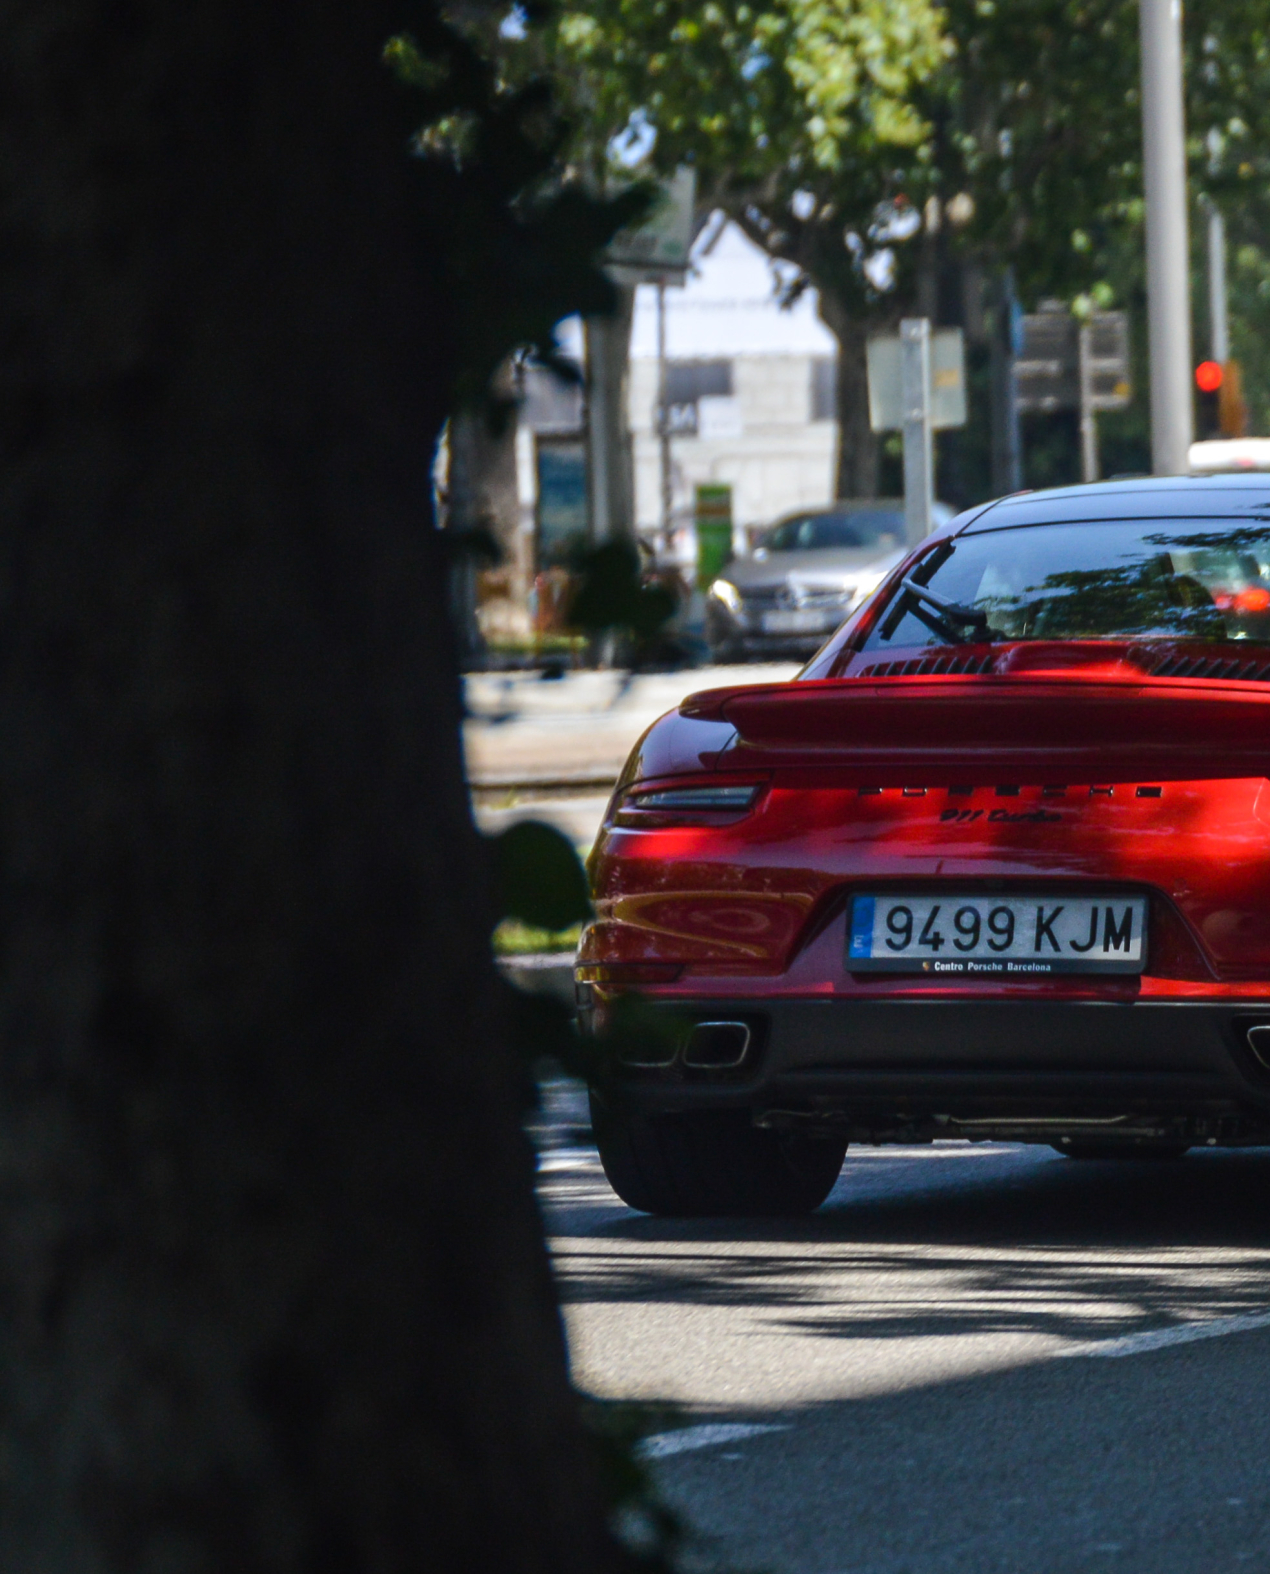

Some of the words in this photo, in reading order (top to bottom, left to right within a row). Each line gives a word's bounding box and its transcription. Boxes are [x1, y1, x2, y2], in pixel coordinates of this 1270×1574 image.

[857, 785, 1162, 799] POCH
[939, 809, 985, 822] 911
[885, 905, 1015, 952] 9499
[1034, 905, 1133, 953] KJM
[934, 961, 963, 971] Centro
[967, 961, 1003, 971] Porsche
[1007, 962, 1051, 972] Barcelona
